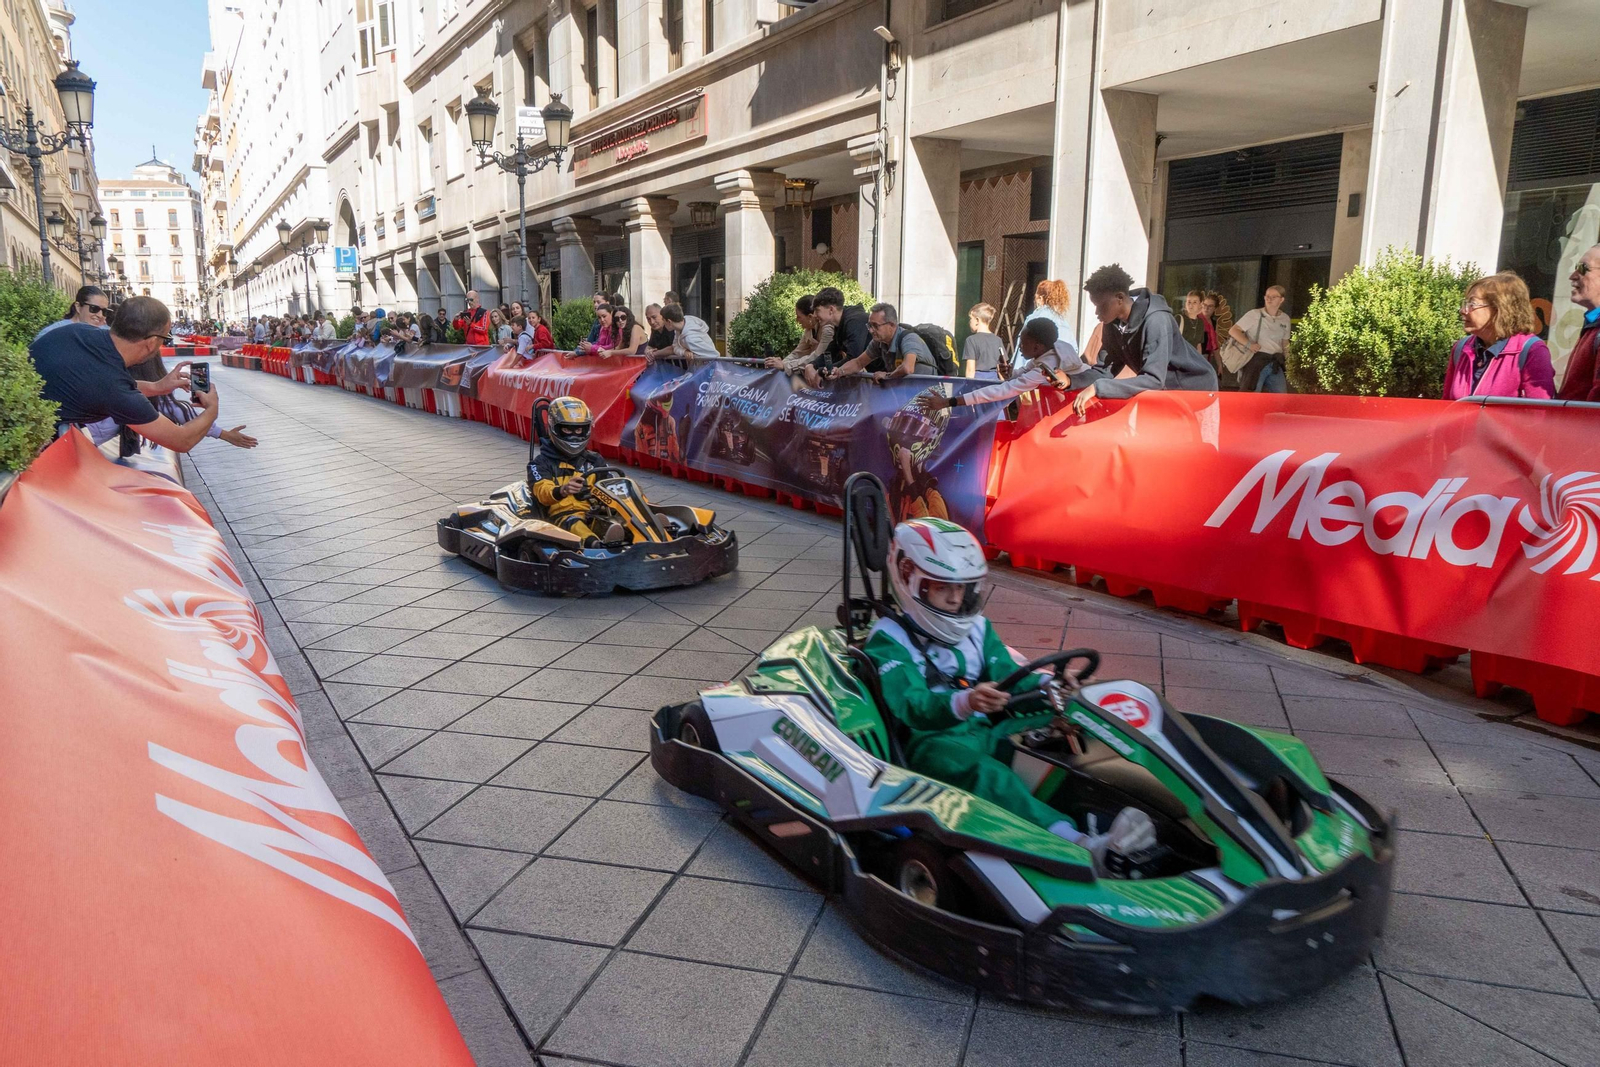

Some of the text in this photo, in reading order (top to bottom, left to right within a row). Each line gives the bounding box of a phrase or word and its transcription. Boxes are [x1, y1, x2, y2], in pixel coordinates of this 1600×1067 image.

[340, 248, 351, 263] P
[738, 385, 769, 403] GANA
[786, 393, 862, 417] CARRERAS QUE
[778, 407, 792, 423] SE
[606, 483, 628, 498] 33
[1204, 449, 1520, 568] Media
[771, 715, 847, 784] COVIRAN
